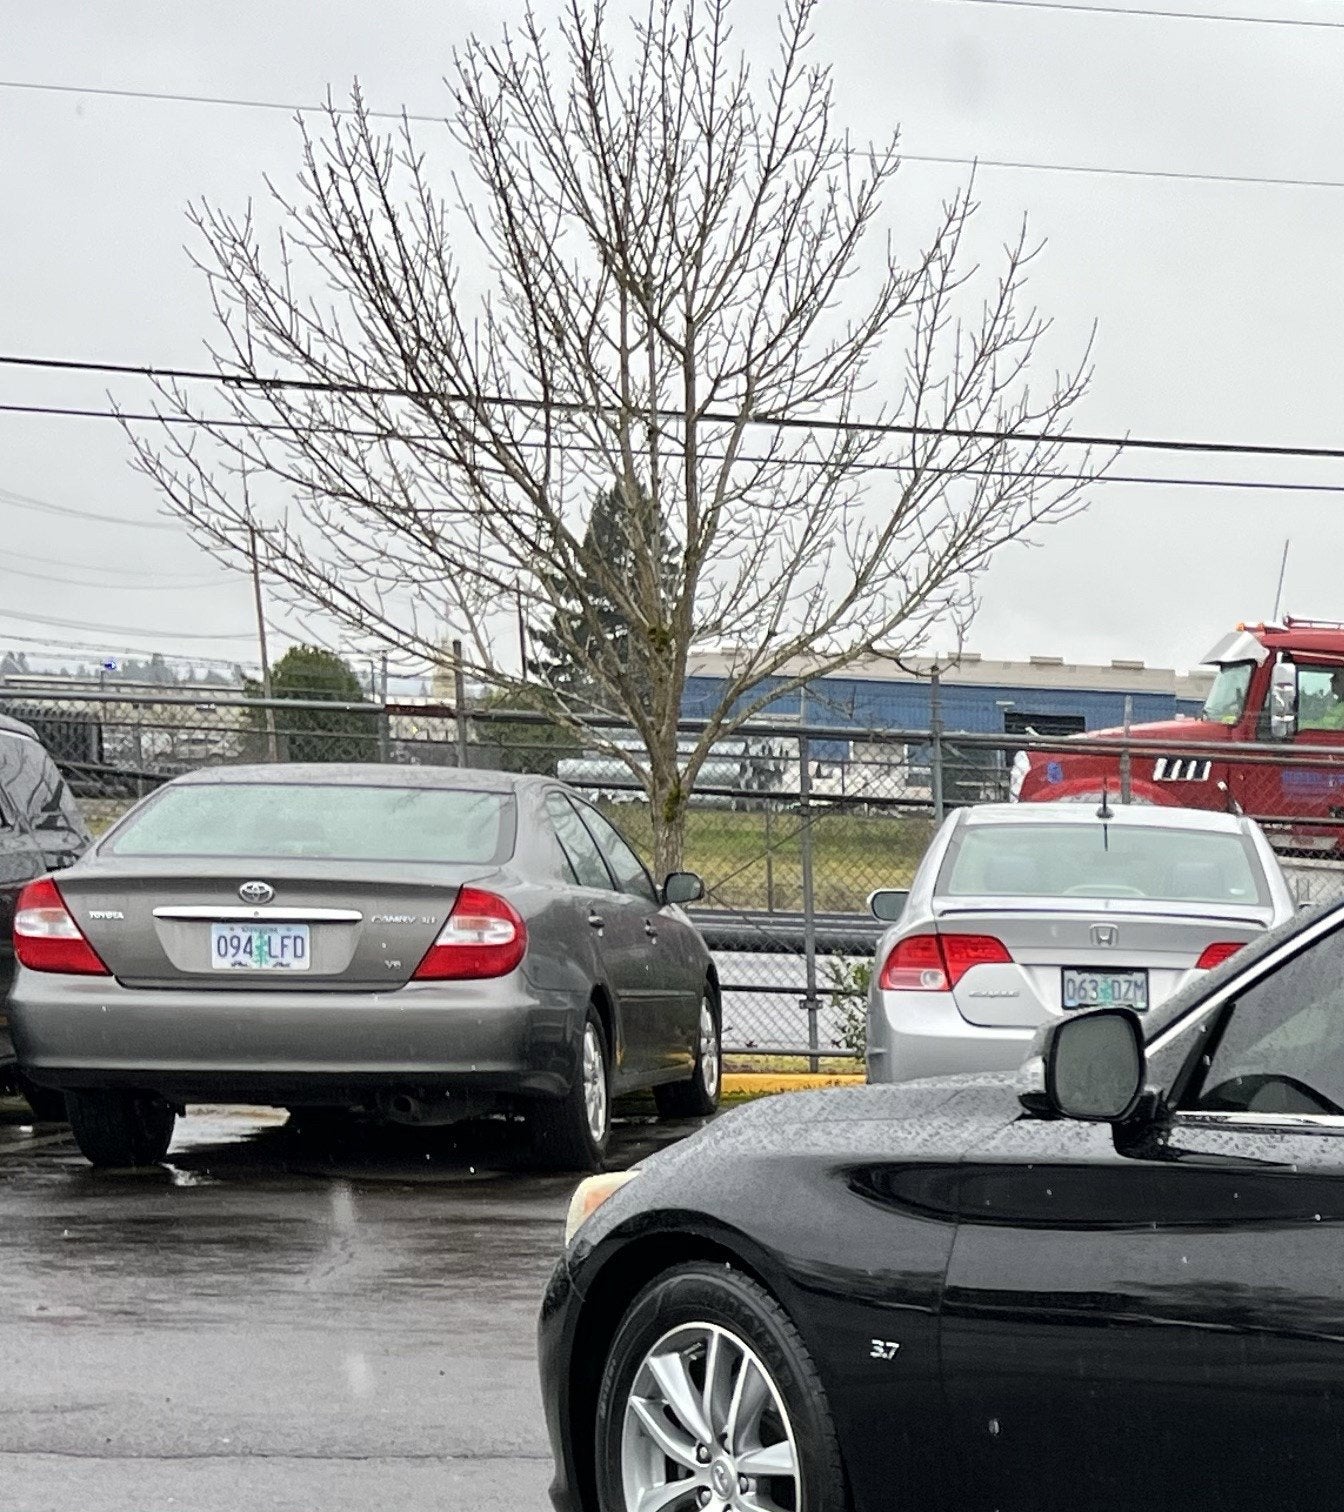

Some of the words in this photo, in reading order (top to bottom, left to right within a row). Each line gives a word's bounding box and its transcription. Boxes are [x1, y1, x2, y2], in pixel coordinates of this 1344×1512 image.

[217, 935, 253, 958] 094
[268, 935, 305, 958] LFD
[1066, 978, 1099, 1001] 063
[1111, 979, 1146, 1003] DZM
